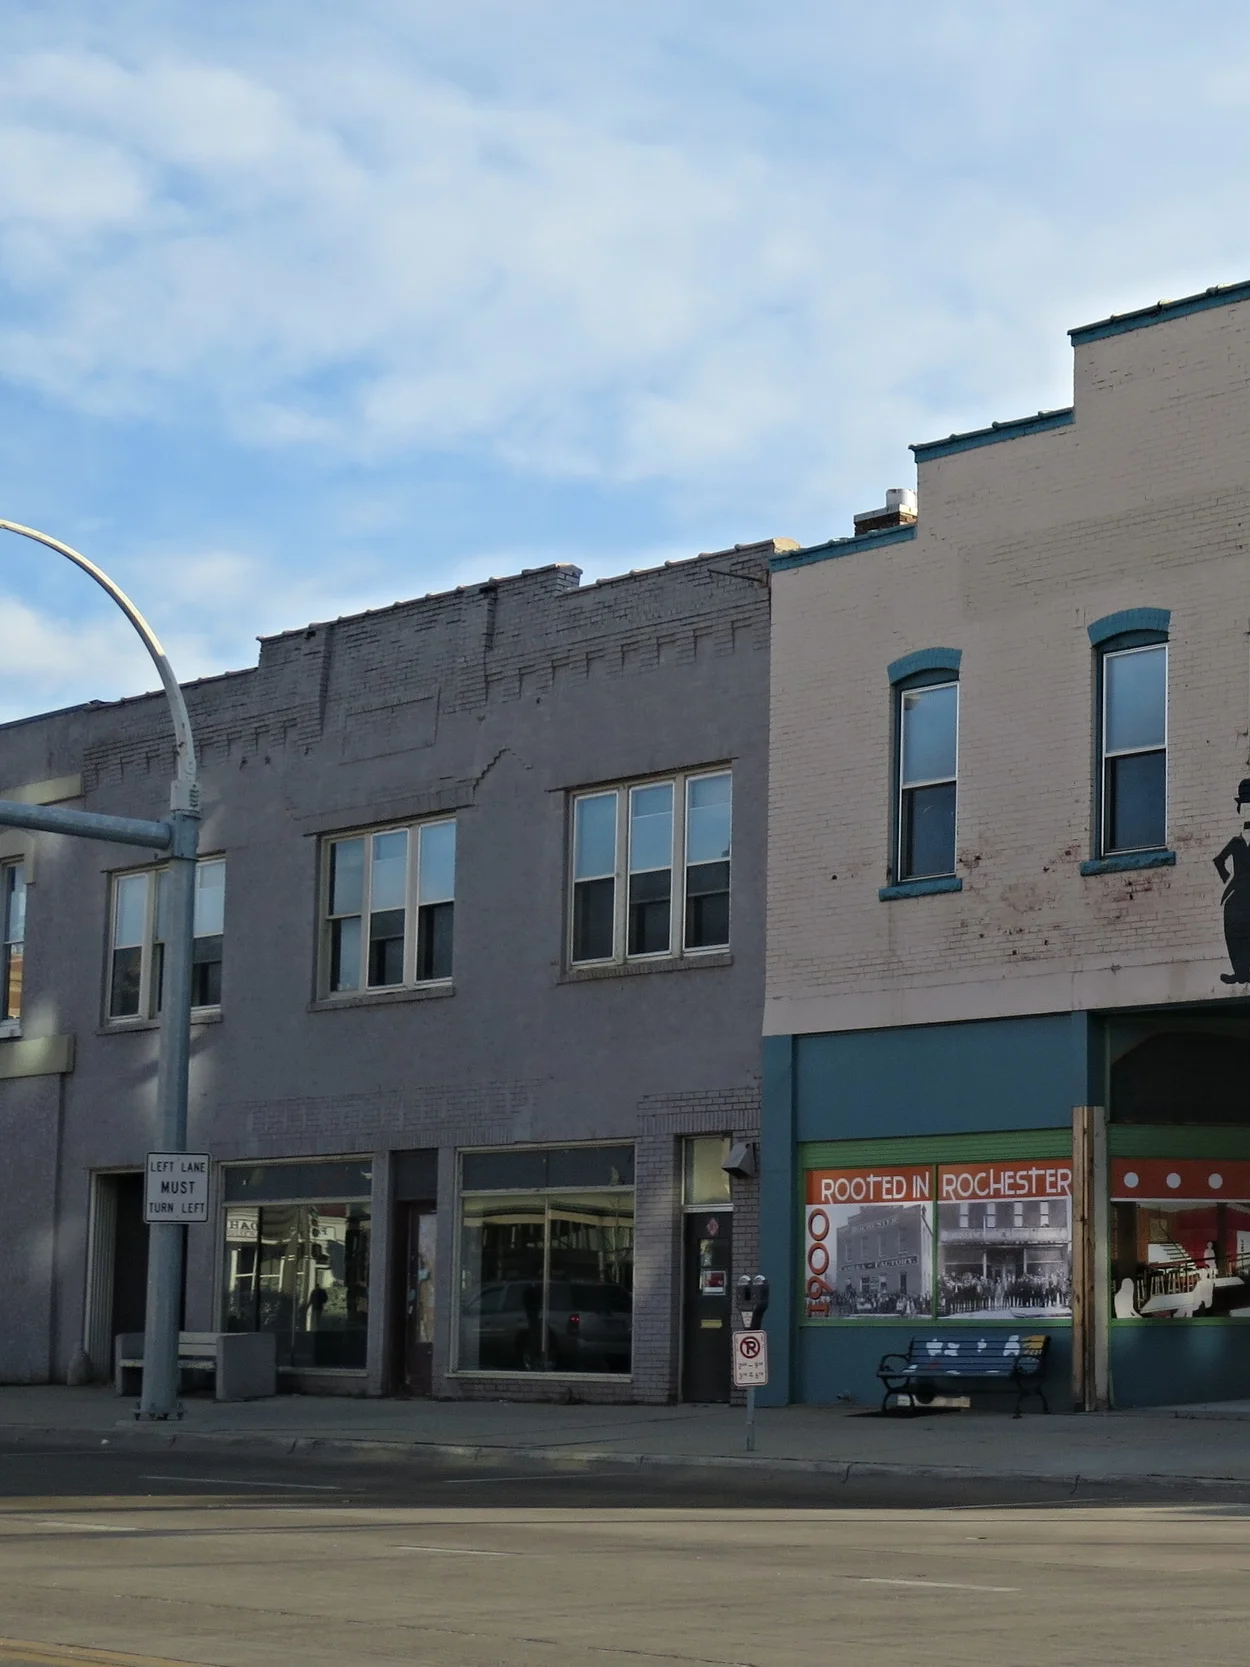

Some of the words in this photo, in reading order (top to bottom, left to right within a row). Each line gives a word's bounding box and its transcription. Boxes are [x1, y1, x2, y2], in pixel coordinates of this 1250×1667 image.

[150, 1161, 174, 1173] LEFT
[181, 1162, 206, 1173] LANE
[161, 1180, 196, 1194] MUST
[821, 1173, 907, 1204] ROOTED
[912, 1171, 929, 1198] IN
[942, 1167, 1072, 1200] ROCHESTER
[149, 1202, 174, 1213] TURN
[181, 1203, 205, 1214] LEFT
[808, 1208, 833, 1318] 1900
